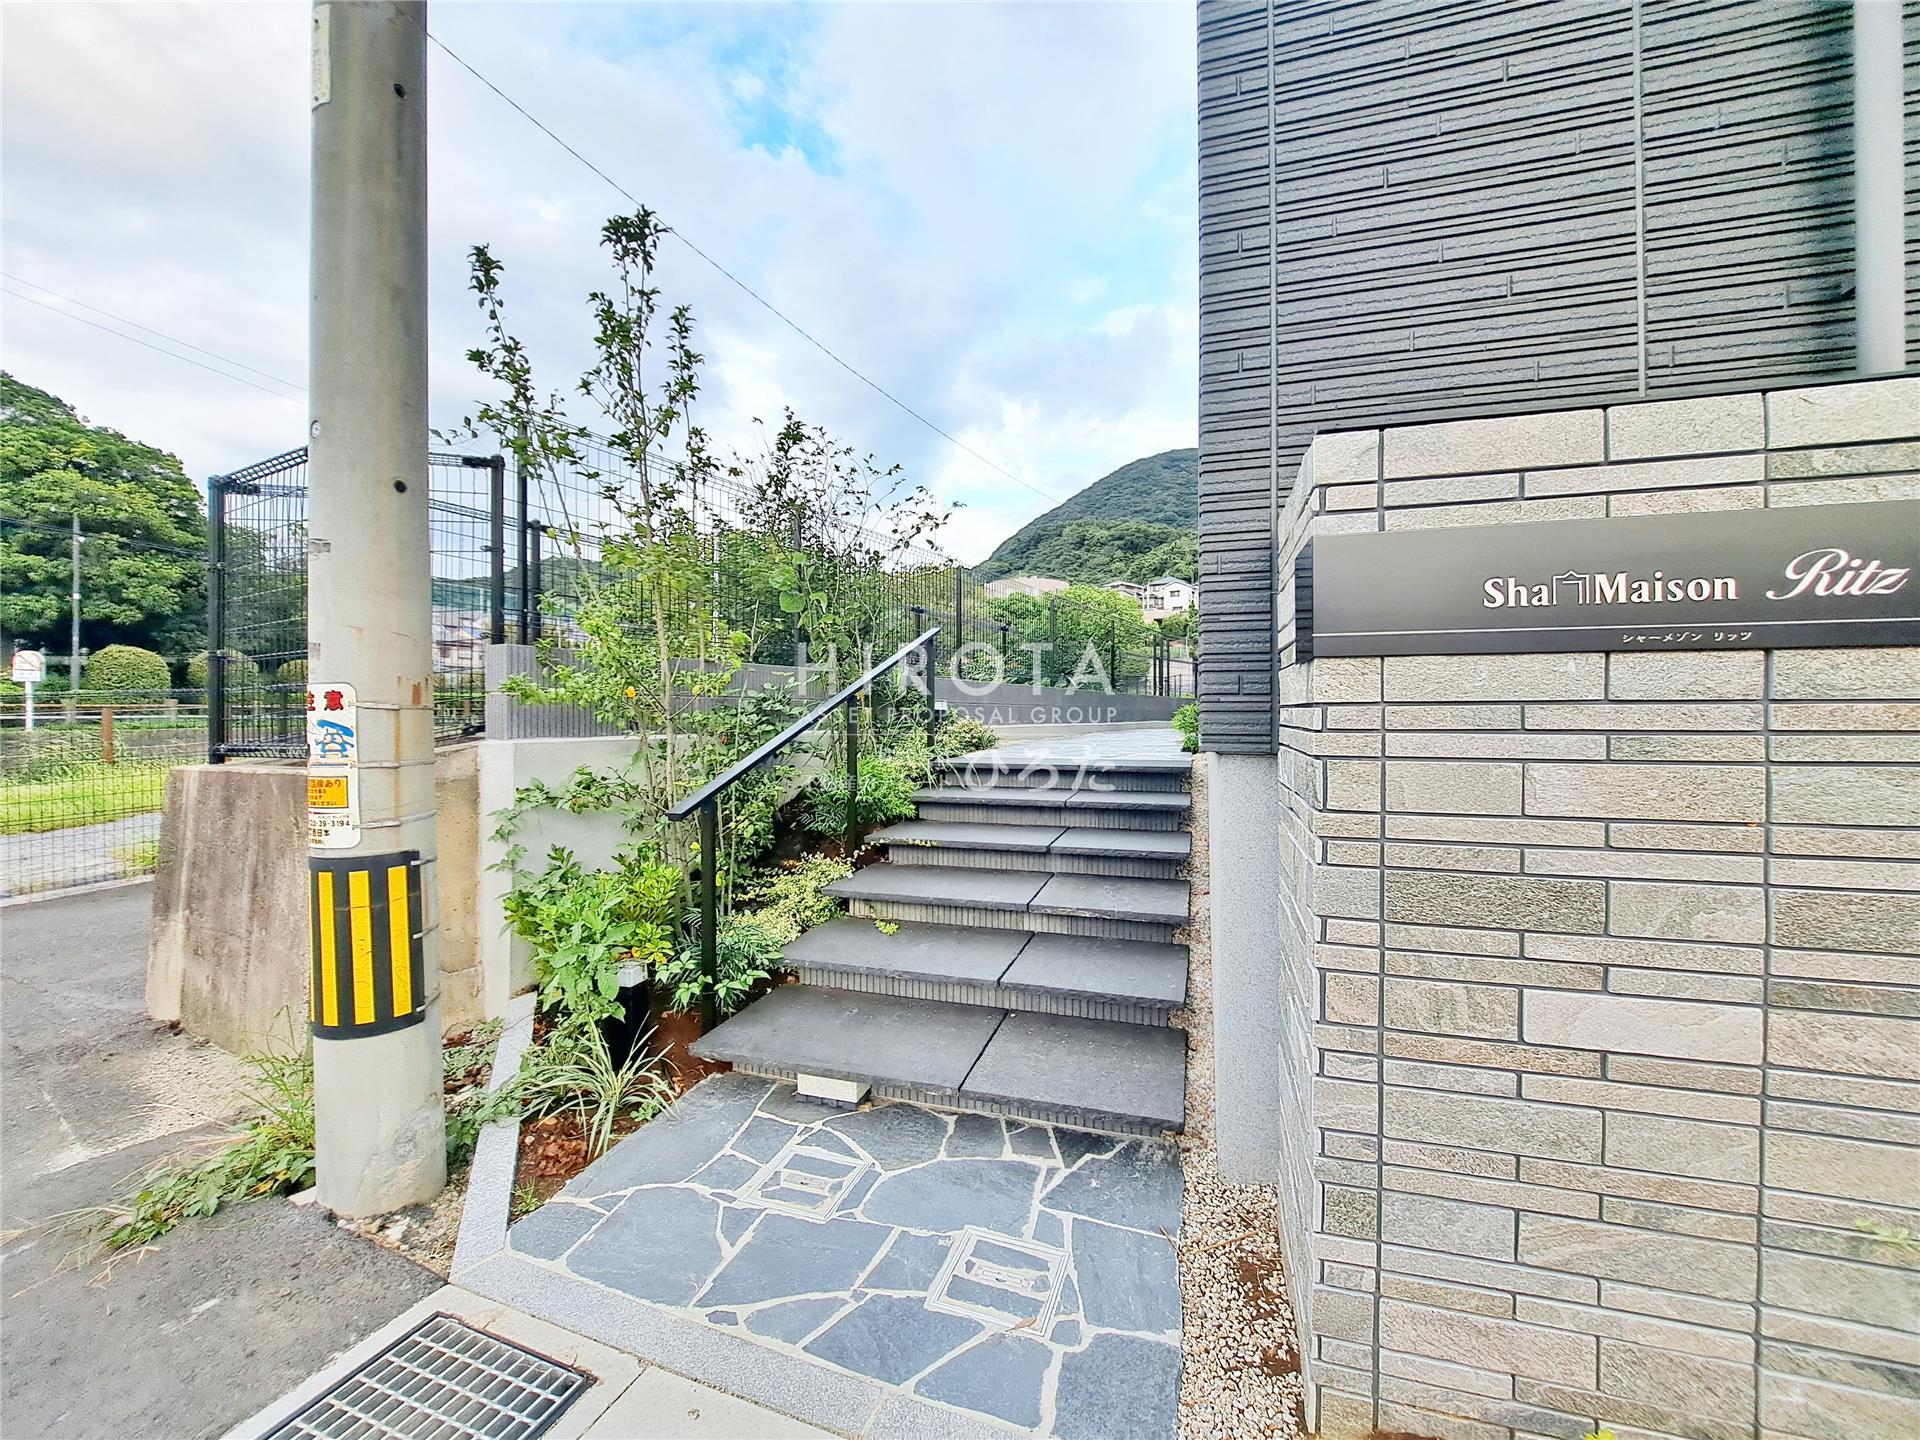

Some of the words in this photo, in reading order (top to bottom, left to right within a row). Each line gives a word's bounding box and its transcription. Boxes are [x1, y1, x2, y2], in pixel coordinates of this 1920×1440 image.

[1765, 548, 1911, 600] Ritz
[1622, 632, 1702, 643] シャーメゾン
[1714, 632, 1752, 641] リッツ
